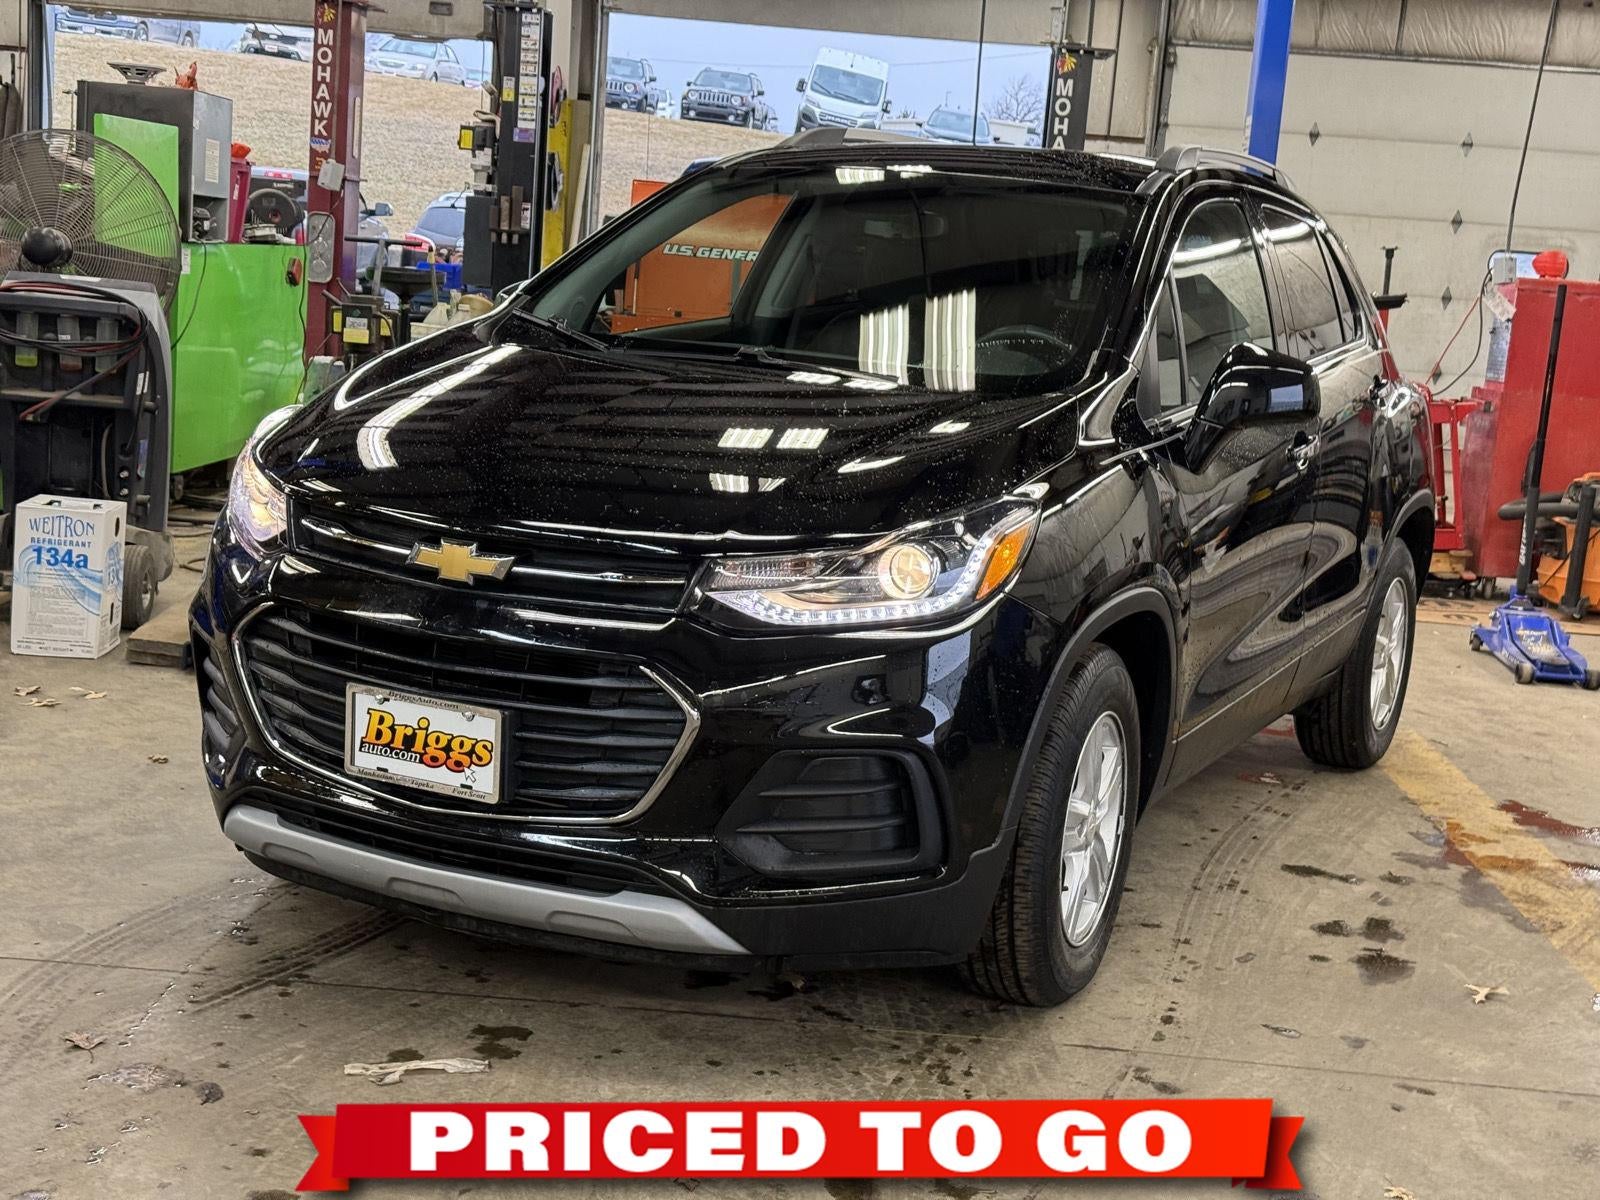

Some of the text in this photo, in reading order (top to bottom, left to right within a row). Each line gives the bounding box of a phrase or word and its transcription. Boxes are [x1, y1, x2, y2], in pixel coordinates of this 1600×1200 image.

[313, 28, 334, 136] MOHAWK
[1051, 78, 1074, 150] MOHA
[663, 243, 694, 257] U.S.
[29, 515, 95, 538] WEITRON
[30, 537, 92, 548] REFRIGERANT
[32, 546, 89, 569] 134a
[361, 708, 493, 773] Briggs
[361, 742, 421, 763] auto.com
